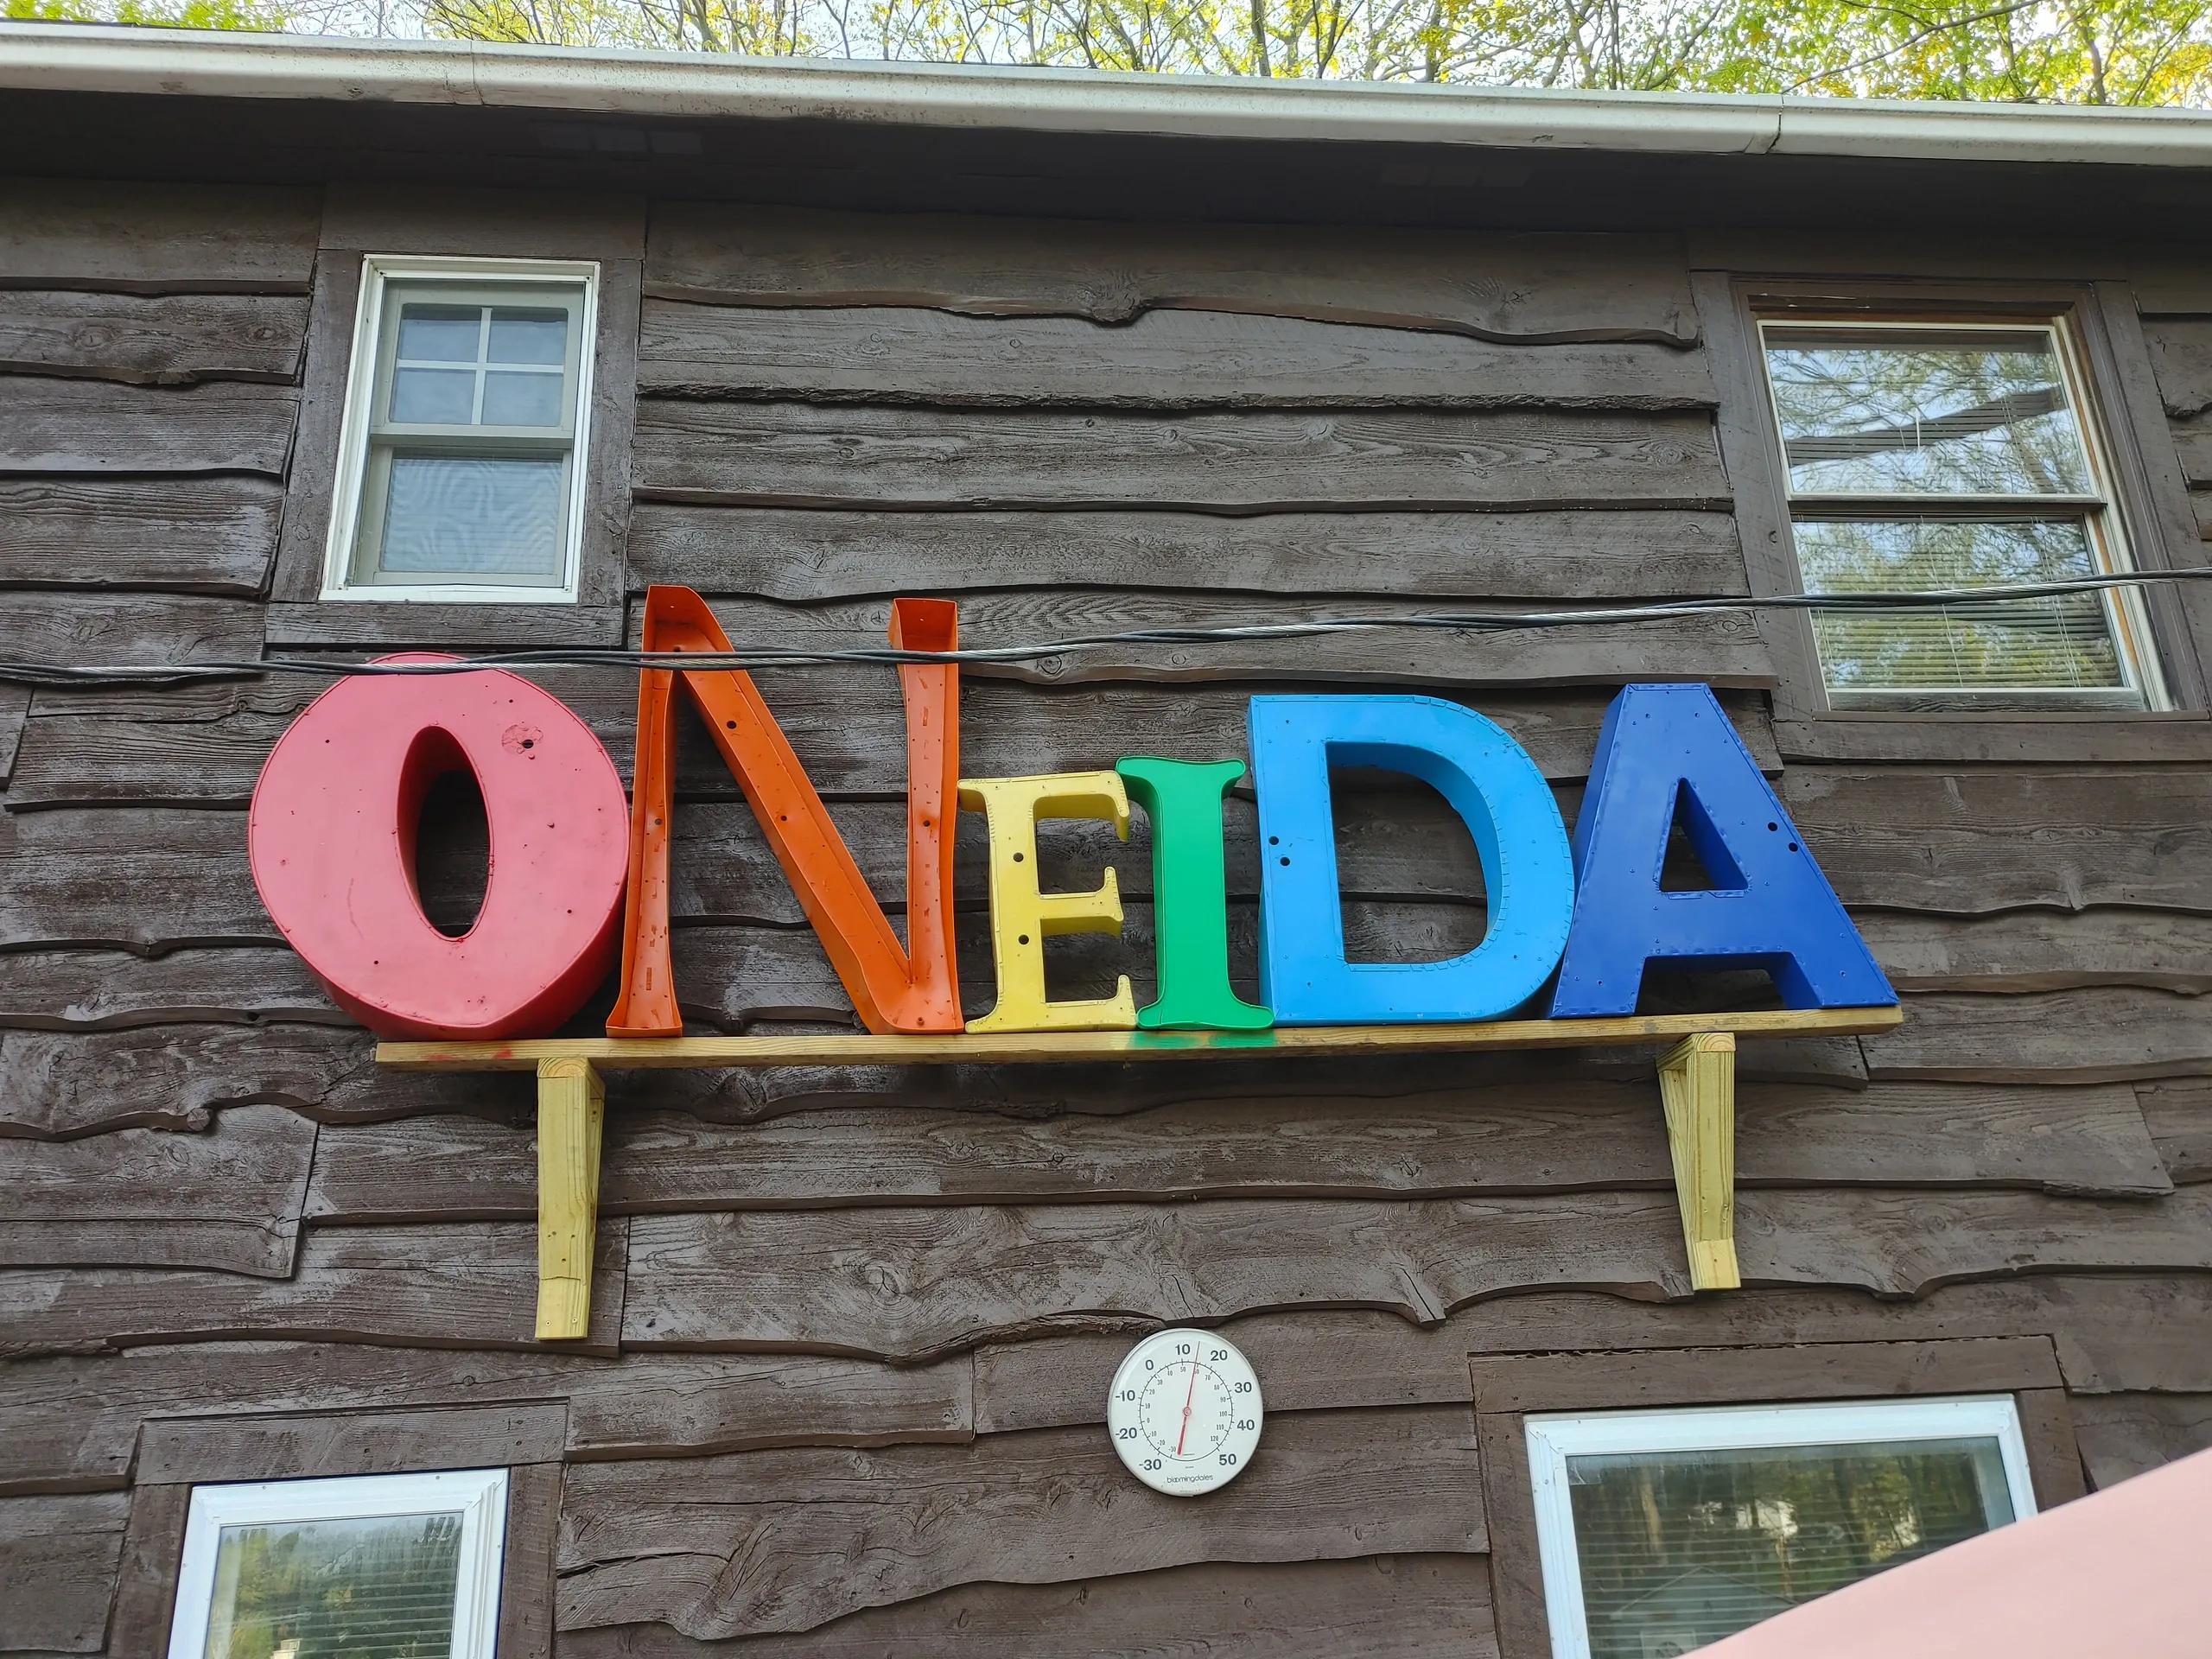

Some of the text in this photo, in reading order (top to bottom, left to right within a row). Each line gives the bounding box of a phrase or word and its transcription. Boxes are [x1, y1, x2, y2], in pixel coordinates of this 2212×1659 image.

[248, 585, 1899, 1039] ONEIDA
[1175, 1344, 1191, 1355] 10
[1210, 1350, 1228, 1361] 20
[1145, 1359, 1154, 1370] 0
[1234, 1382, 1252, 1394] 30
[1116, 1389, 1135, 1402] -10
[1236, 1419, 1255, 1431] 40
[1116, 1427, 1137, 1440] -20
[1139, 1459, 1161, 1471] -30
[1218, 1453, 1236, 1465] 50
[1166, 1474, 1214, 1484] bloomingdales
